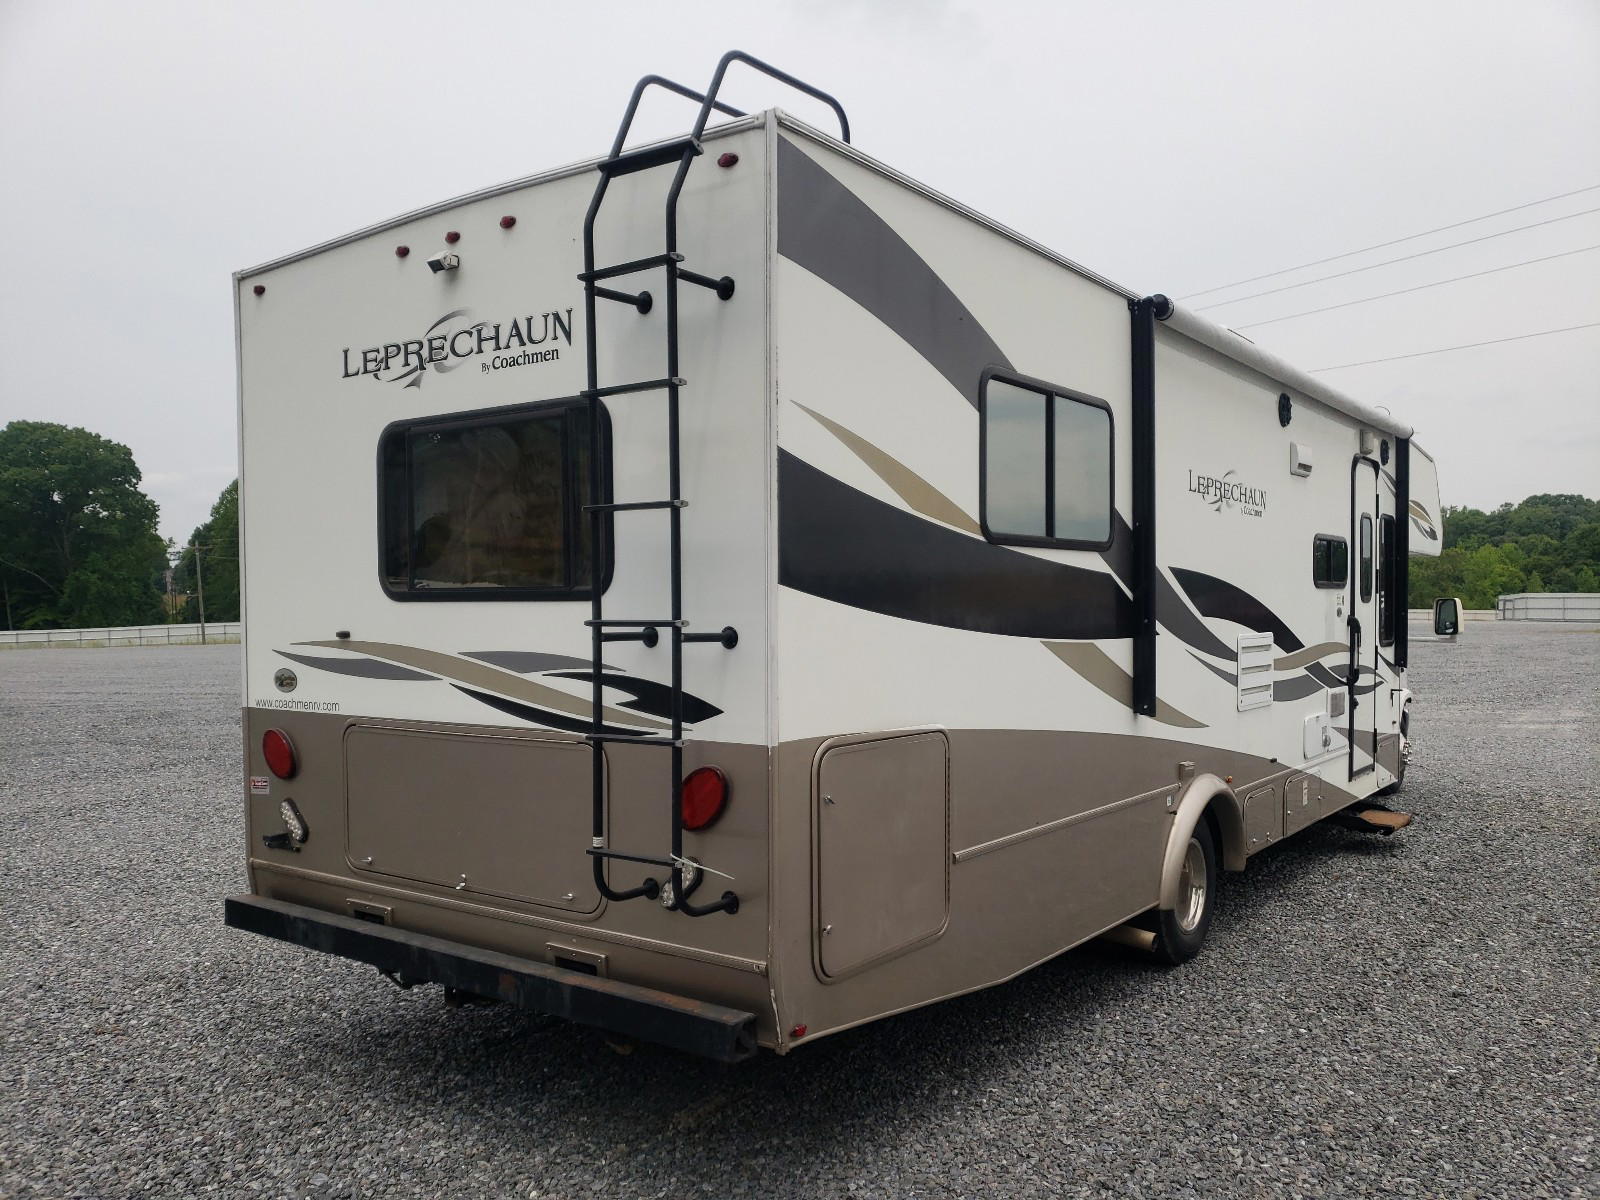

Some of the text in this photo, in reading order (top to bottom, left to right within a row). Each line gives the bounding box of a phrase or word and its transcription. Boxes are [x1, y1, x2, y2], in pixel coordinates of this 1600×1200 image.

[342, 308, 573, 378] LEPRECHAUN
[481, 348, 560, 374] By Coachmen
[1188, 469, 1267, 510] LEPRECHAUN
[255, 698, 340, 712] www.coachmenrv.com
